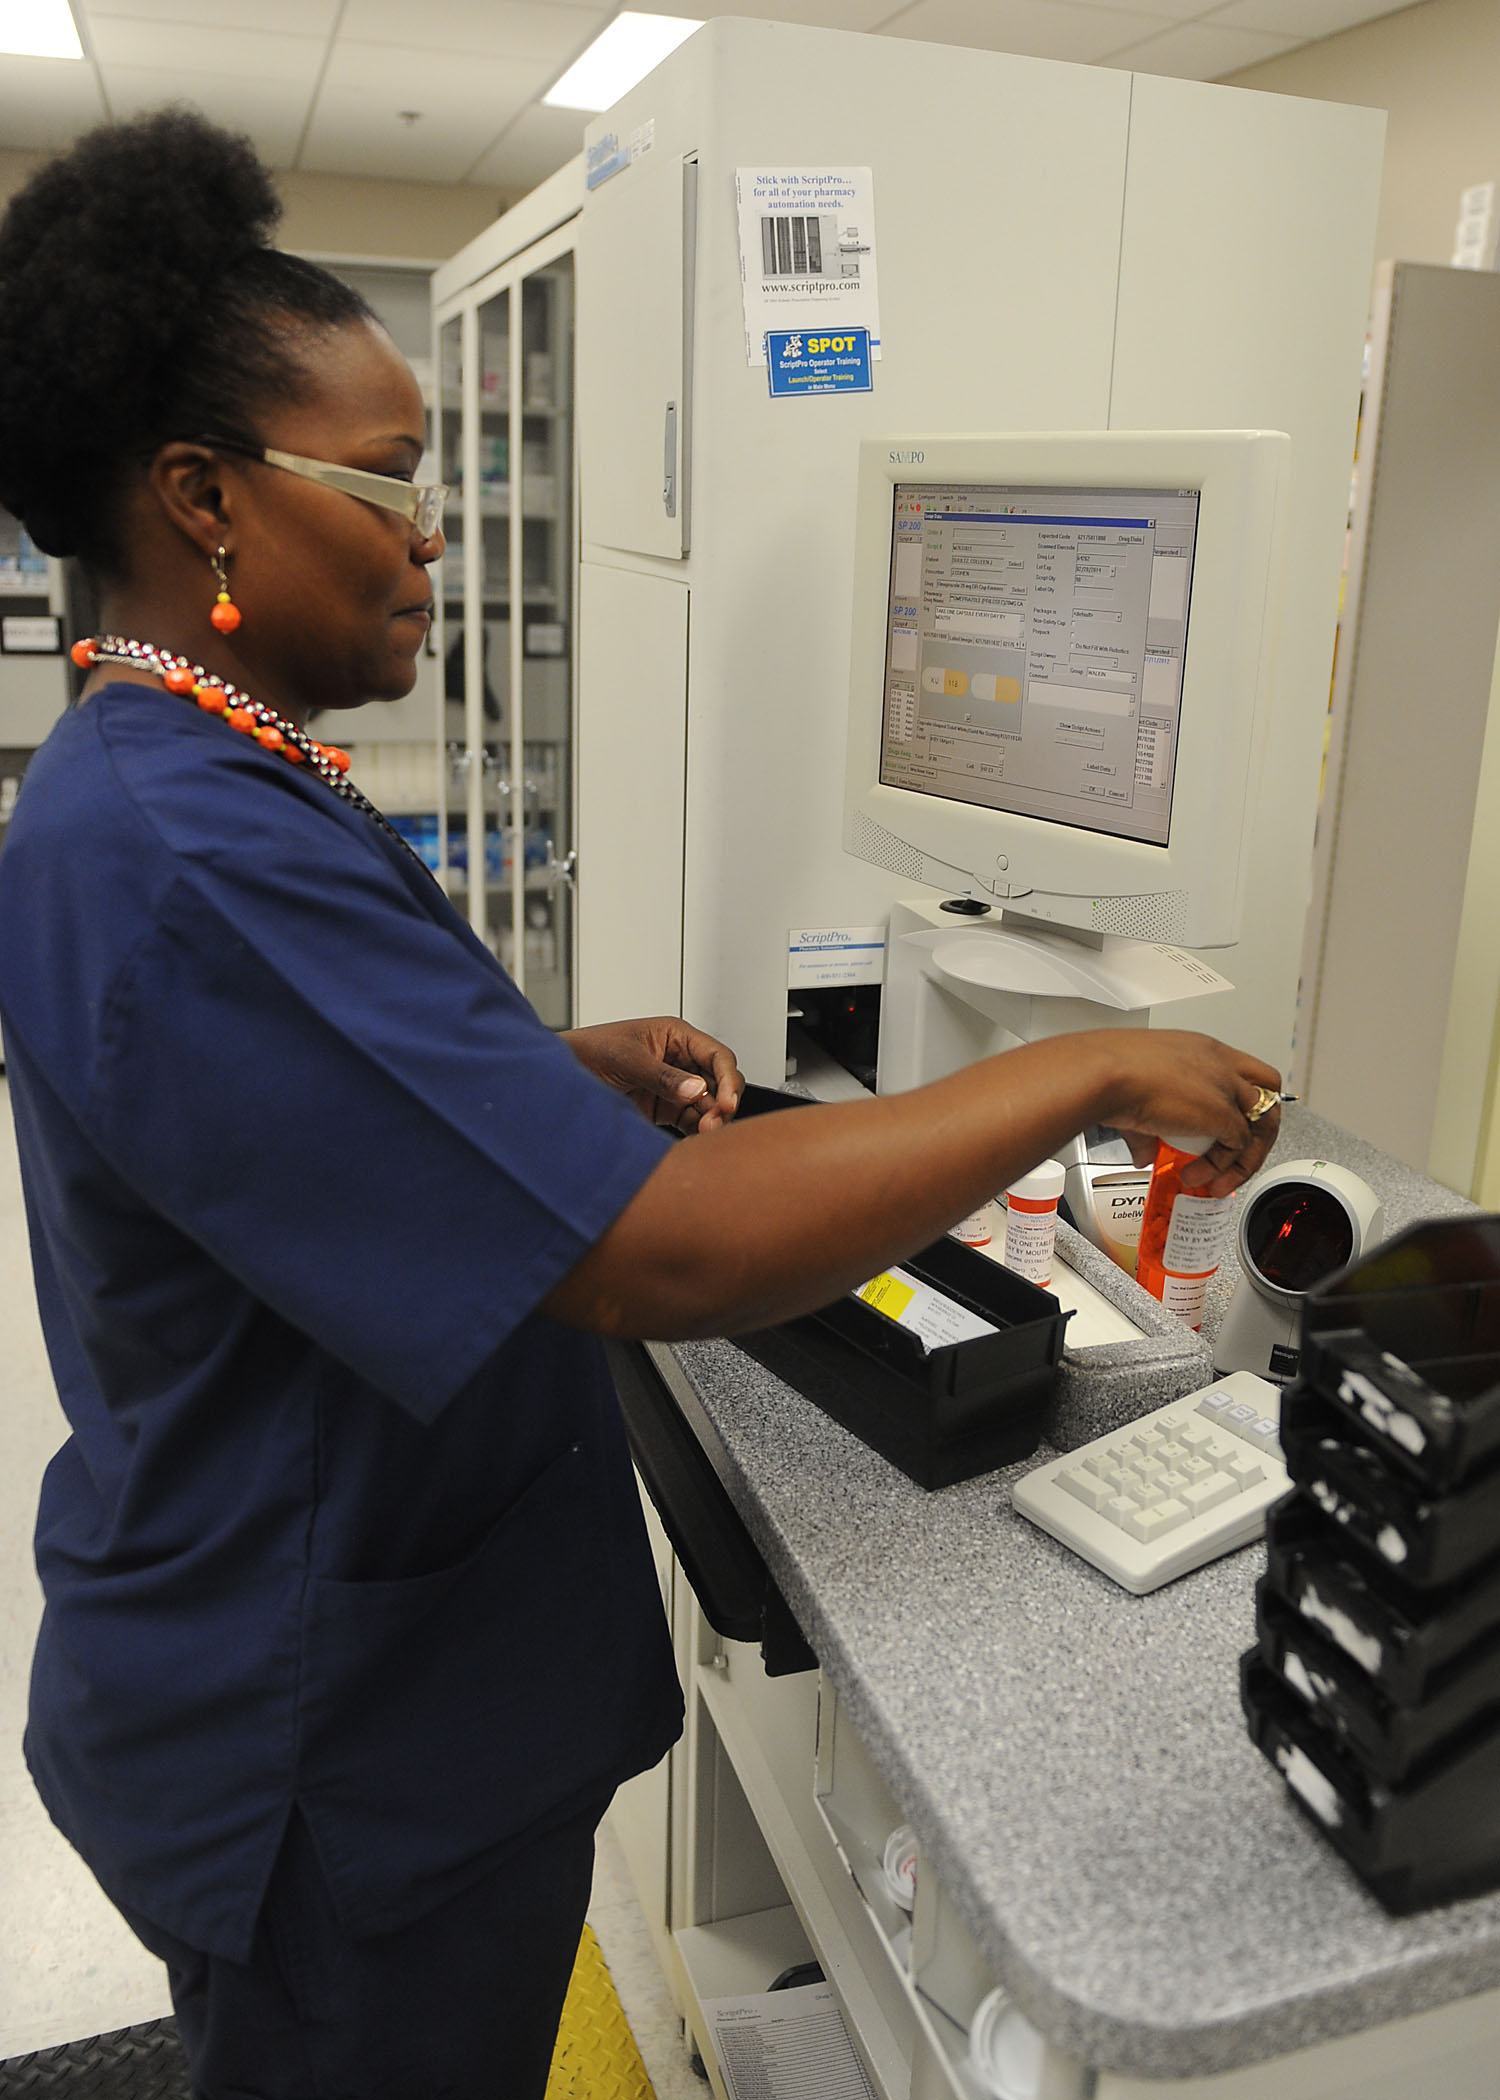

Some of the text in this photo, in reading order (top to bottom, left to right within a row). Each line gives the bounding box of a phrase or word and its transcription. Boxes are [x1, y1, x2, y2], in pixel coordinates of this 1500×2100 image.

[756, 176, 778, 185] Stick
[780, 176, 800, 185] with
[753, 187, 856, 198] for all of your pharmacy
[768, 199, 844, 209] automation needs.
[762, 281, 860, 294] www.scriptpro.com
[807, 336, 857, 354] SPOT
[779, 357, 861, 370] ScriptPro Operator Training
[832, 374, 854, 382] Training
[889, 451, 925, 464] SAMPO
[898, 521, 921, 530] SP 200
[893, 606, 917, 616] SP 200
[956, 609, 974, 617] CAPSULE
[1108, 790, 1126, 798] Cancel
[799, 931, 849, 944] ScriptPro
[1112, 1210, 1145, 1219] LabelW
[1175, 1224, 1194, 1234] TAKE
[1197, 1226, 1212, 1235] ONE
[1172, 1233, 1189, 1242] DAY
